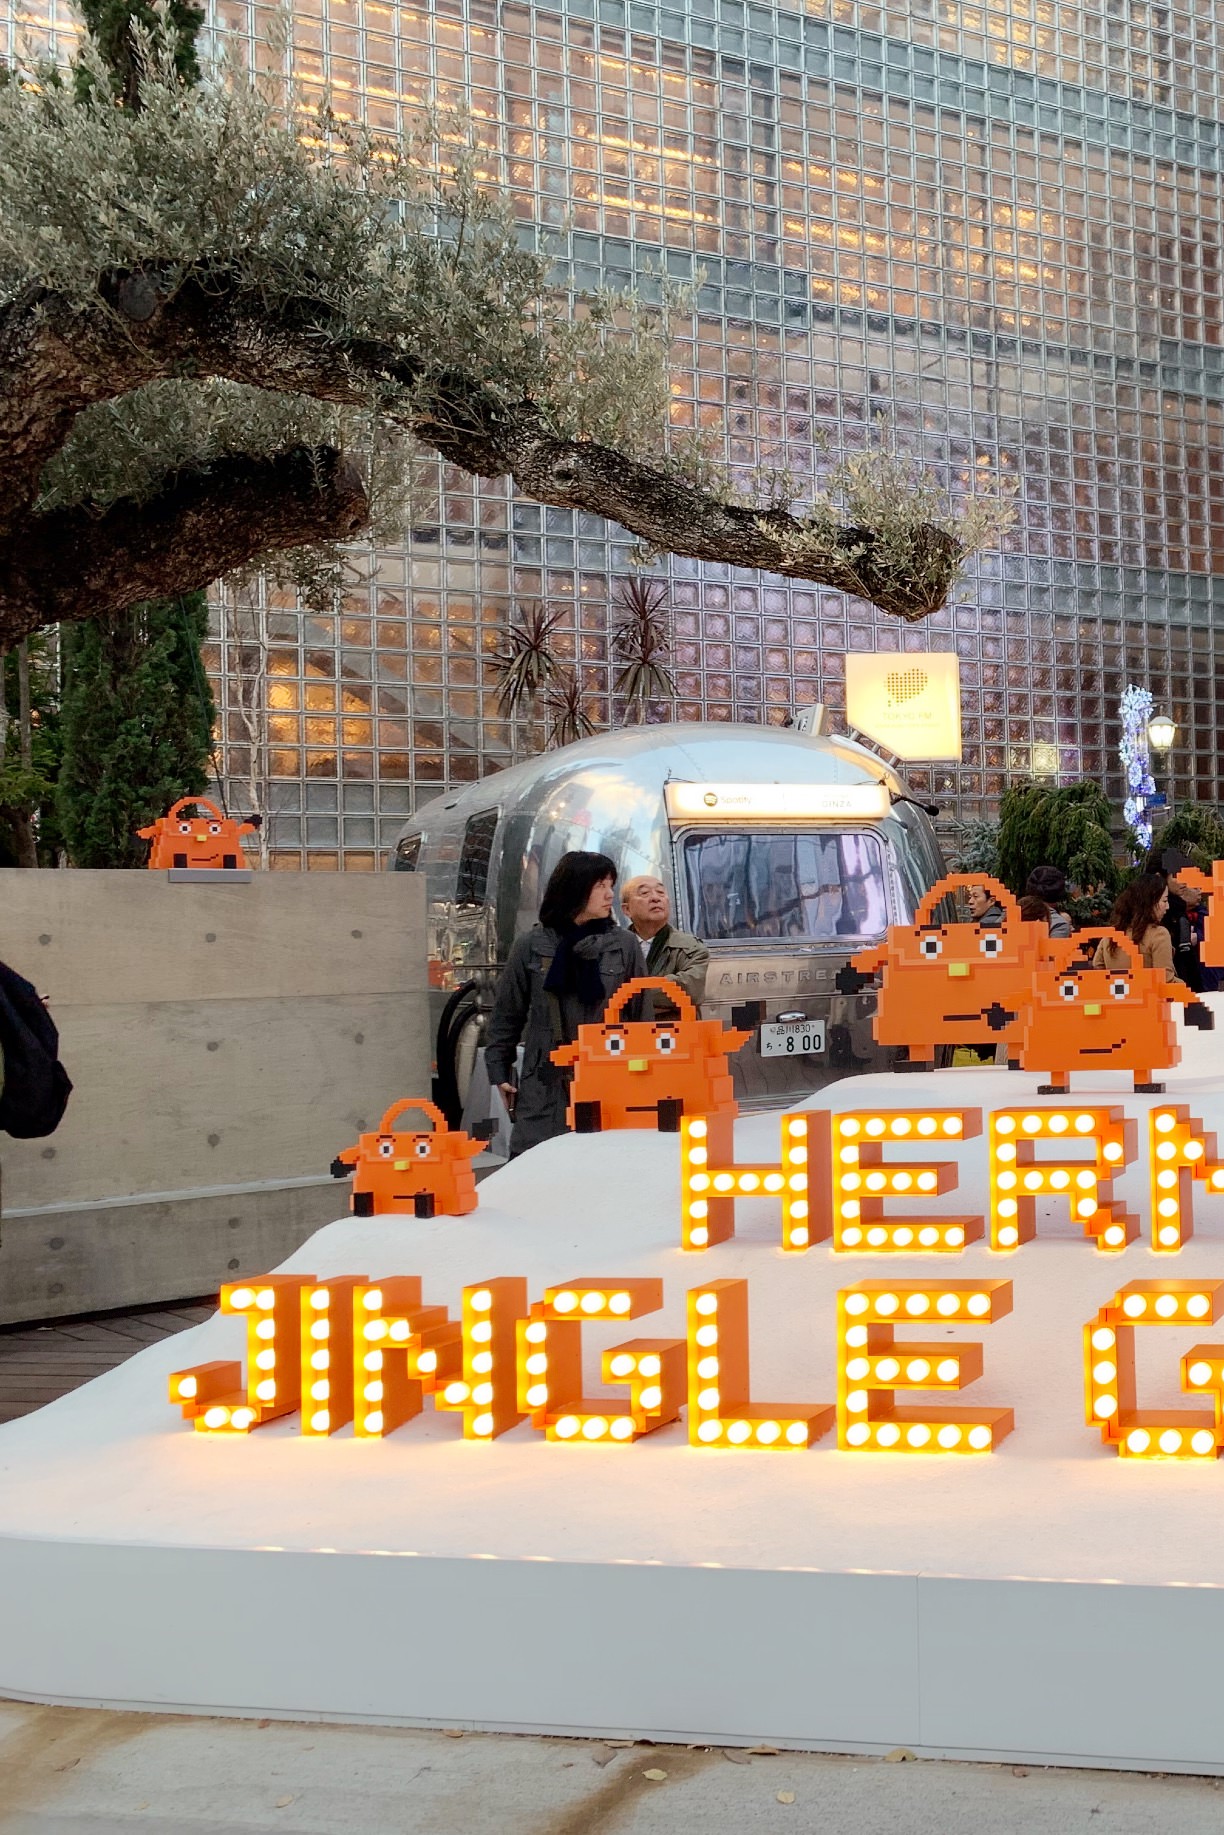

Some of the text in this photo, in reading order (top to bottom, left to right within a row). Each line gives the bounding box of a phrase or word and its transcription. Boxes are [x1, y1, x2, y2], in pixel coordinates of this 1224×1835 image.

[720, 796, 751, 805] Spotify
[822, 800, 852, 808] GINZA
[168, 1275, 1015, 1455] JINGLE
